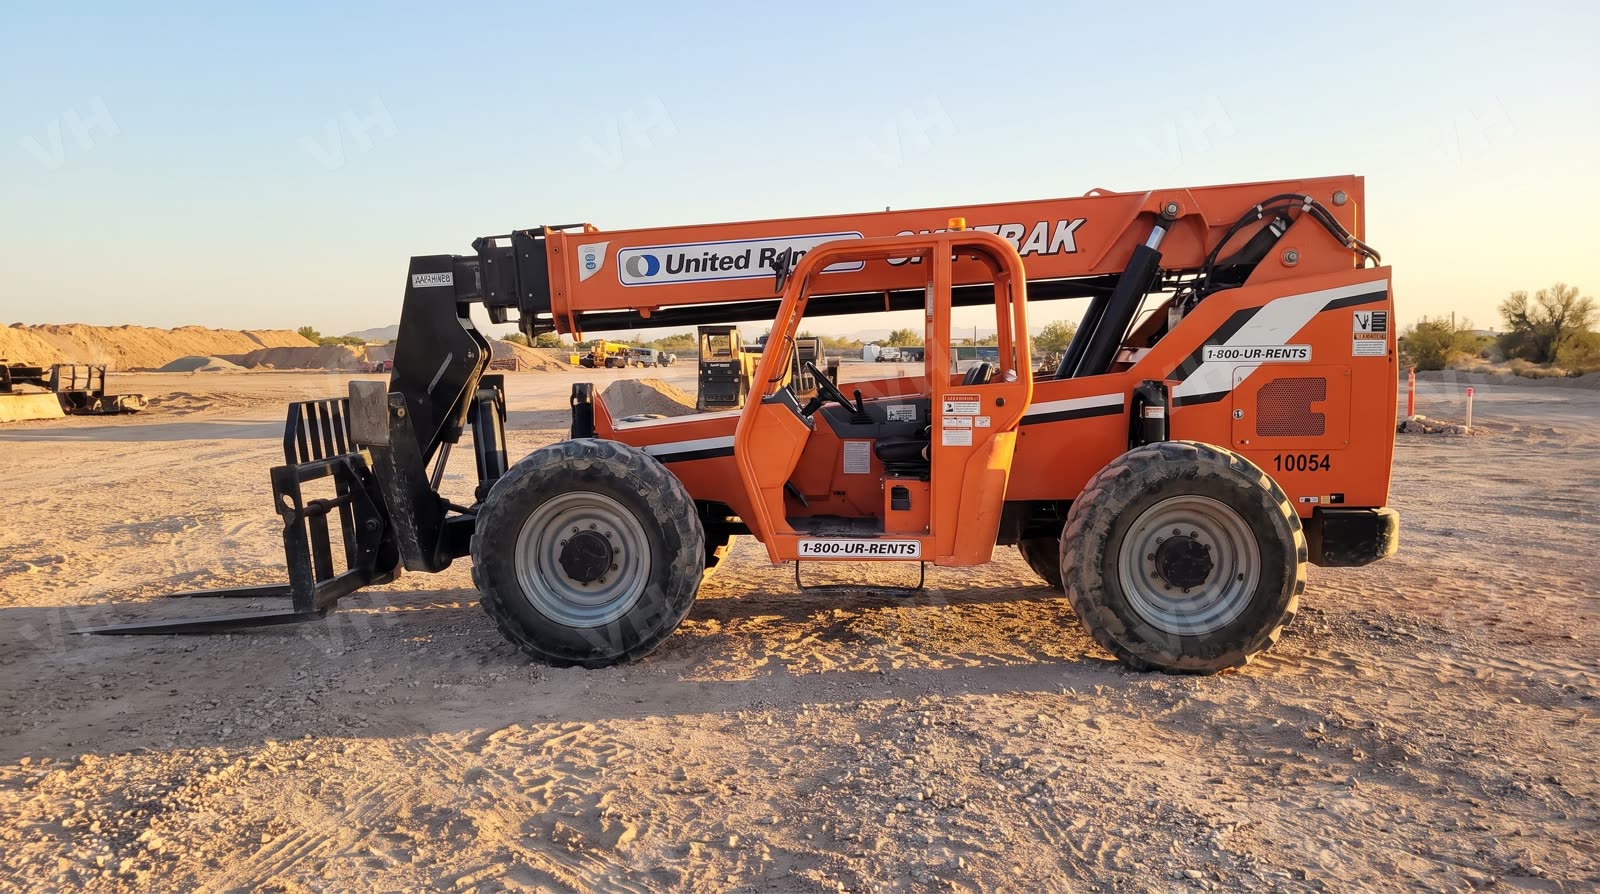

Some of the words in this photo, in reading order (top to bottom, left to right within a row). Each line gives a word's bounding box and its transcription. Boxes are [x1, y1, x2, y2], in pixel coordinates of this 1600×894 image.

[665, 249, 751, 275] United
[1208, 348, 1307, 360] 1-800-UR-RENTS
[1274, 454, 1331, 472] 10054
[802, 543, 916, 555] 1-800-UR-RENTS
